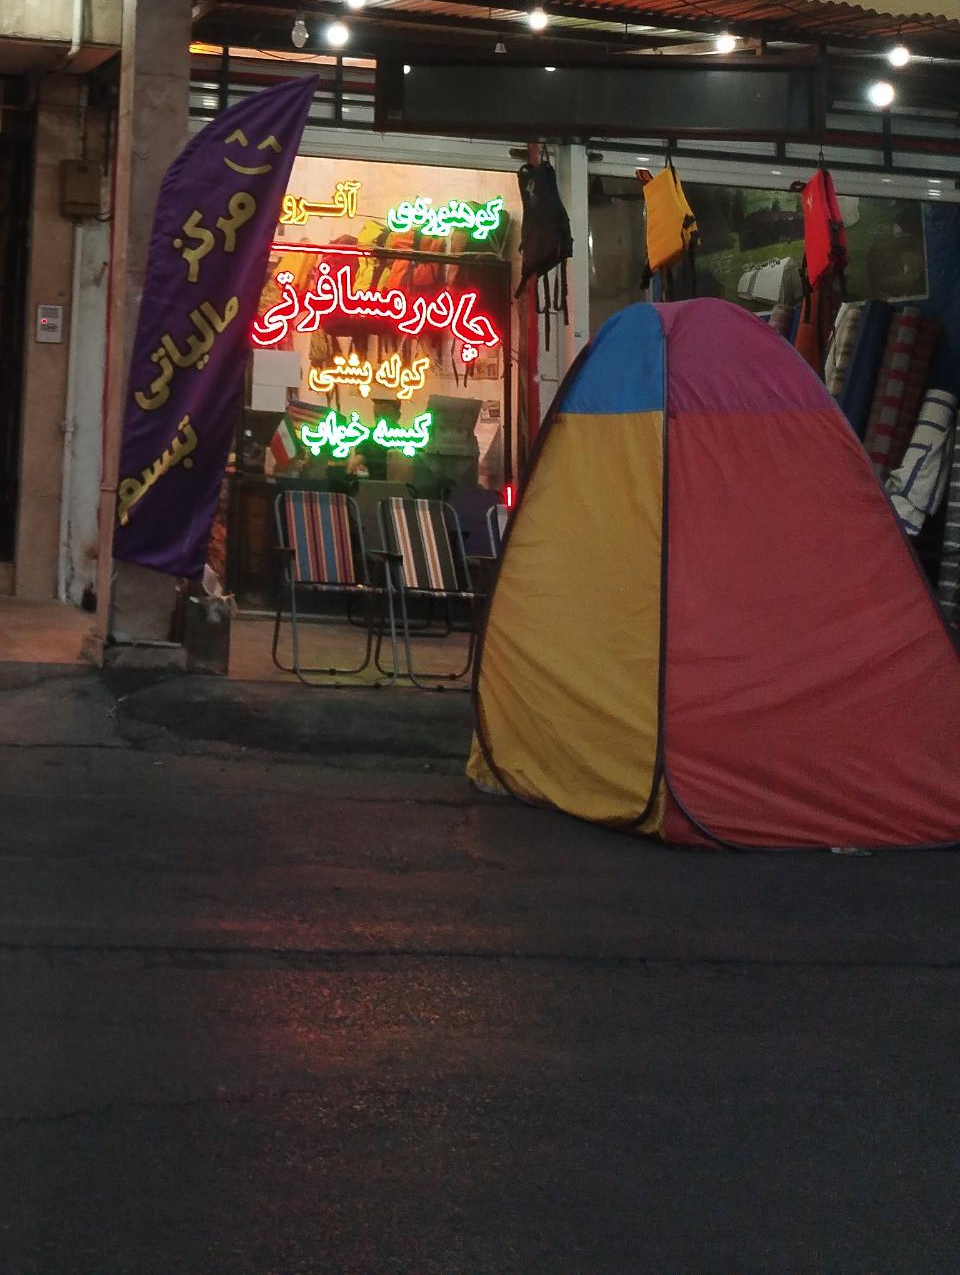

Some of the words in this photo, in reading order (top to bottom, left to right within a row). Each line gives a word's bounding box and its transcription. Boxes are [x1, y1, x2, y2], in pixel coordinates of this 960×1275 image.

[173, 191, 256, 283] مرکز
[387, 196, 503, 239] کوهنوردی
[251, 263, 407, 346] مسافرتی
[399, 291, 501, 362] چادر
[134, 295, 240, 411] مالیاتی
[308, 354, 372, 398] پشتی
[375, 354, 430, 400] کوله
[301, 410, 369, 458] خواب
[372, 411, 432, 458] کیسه
[117, 415, 199, 525] تبسم
